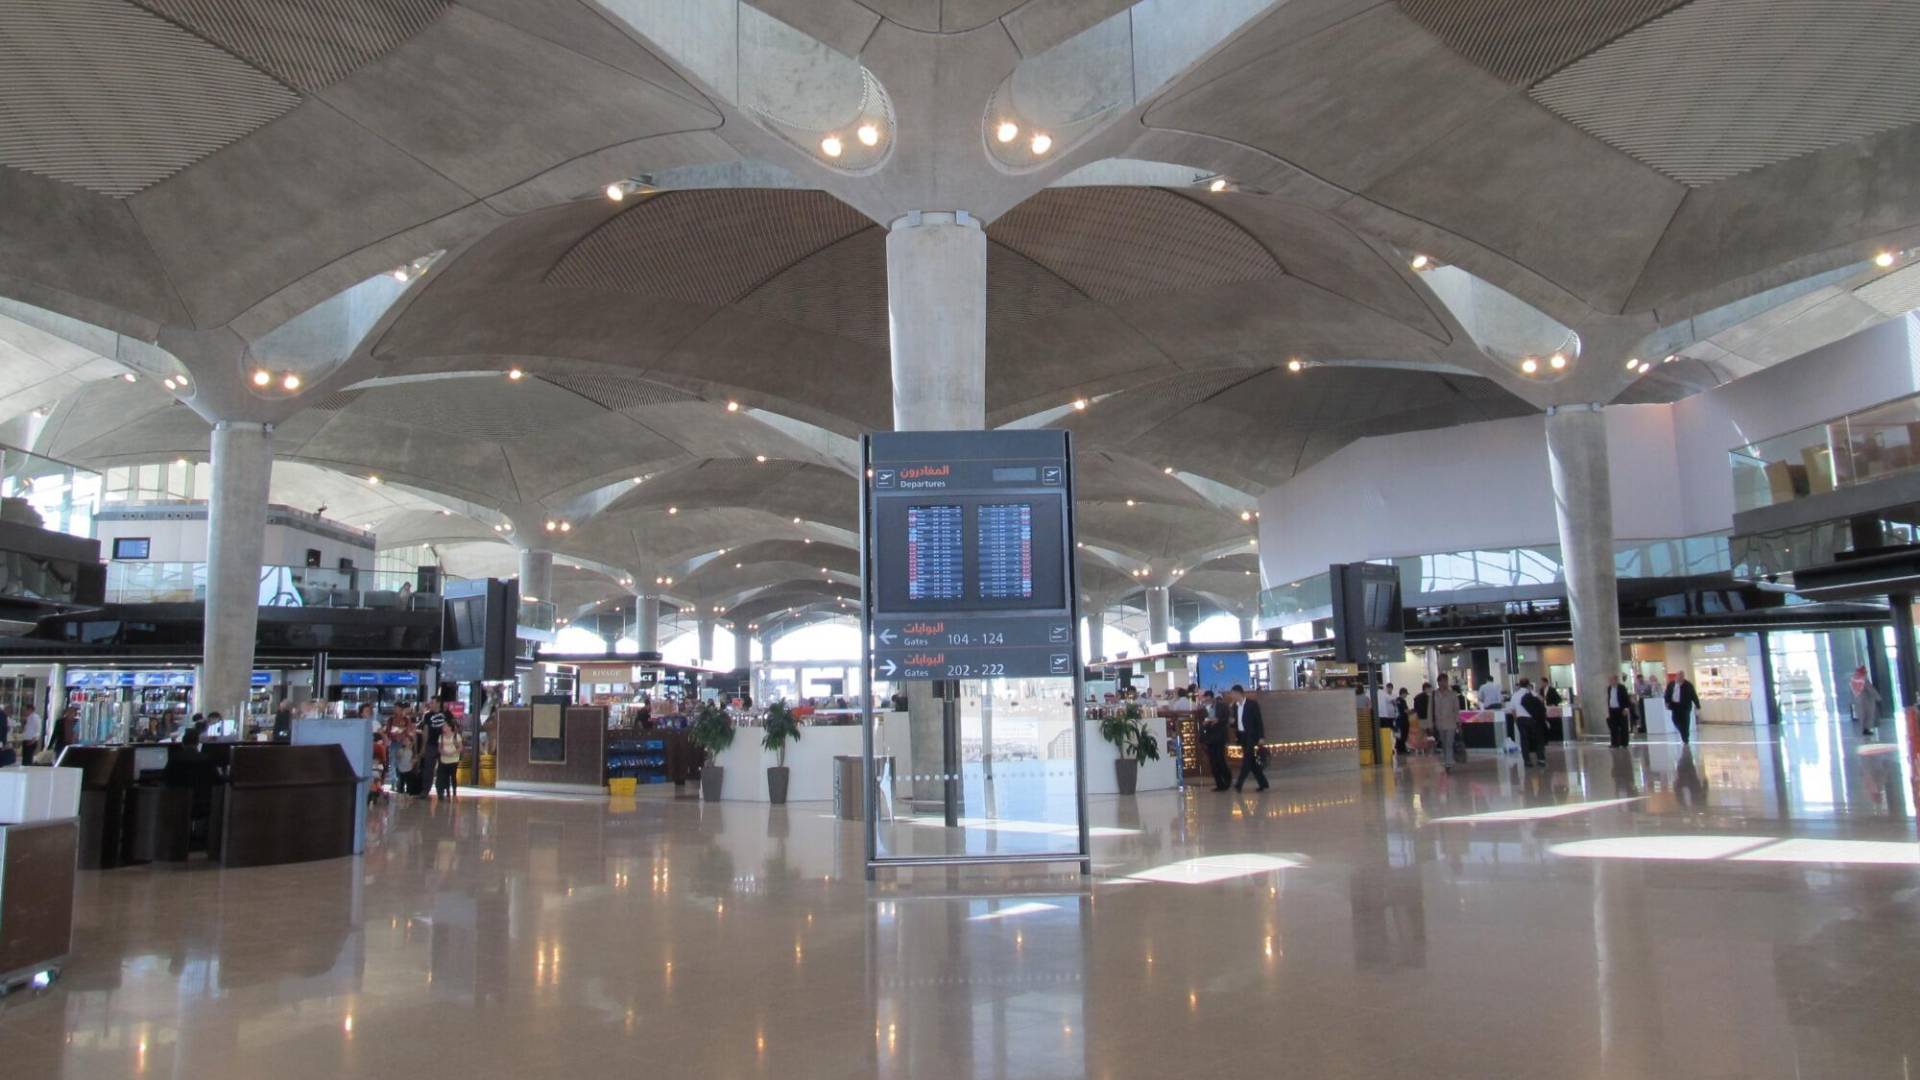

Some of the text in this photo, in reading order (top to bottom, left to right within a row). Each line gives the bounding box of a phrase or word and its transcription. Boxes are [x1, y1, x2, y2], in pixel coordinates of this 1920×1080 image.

[900, 464, 950, 479] المغادرون
[900, 480, 946, 489] Departures
[903, 622, 945, 634] البوابات
[904, 638, 929, 646] Gates
[947, 634, 969, 645] 104
[983, 633, 1004, 644] 124
[903, 654, 945, 665] البوابات
[904, 669, 929, 677] Gates
[947, 665, 970, 676] 202
[982, 664, 1005, 675] 222
